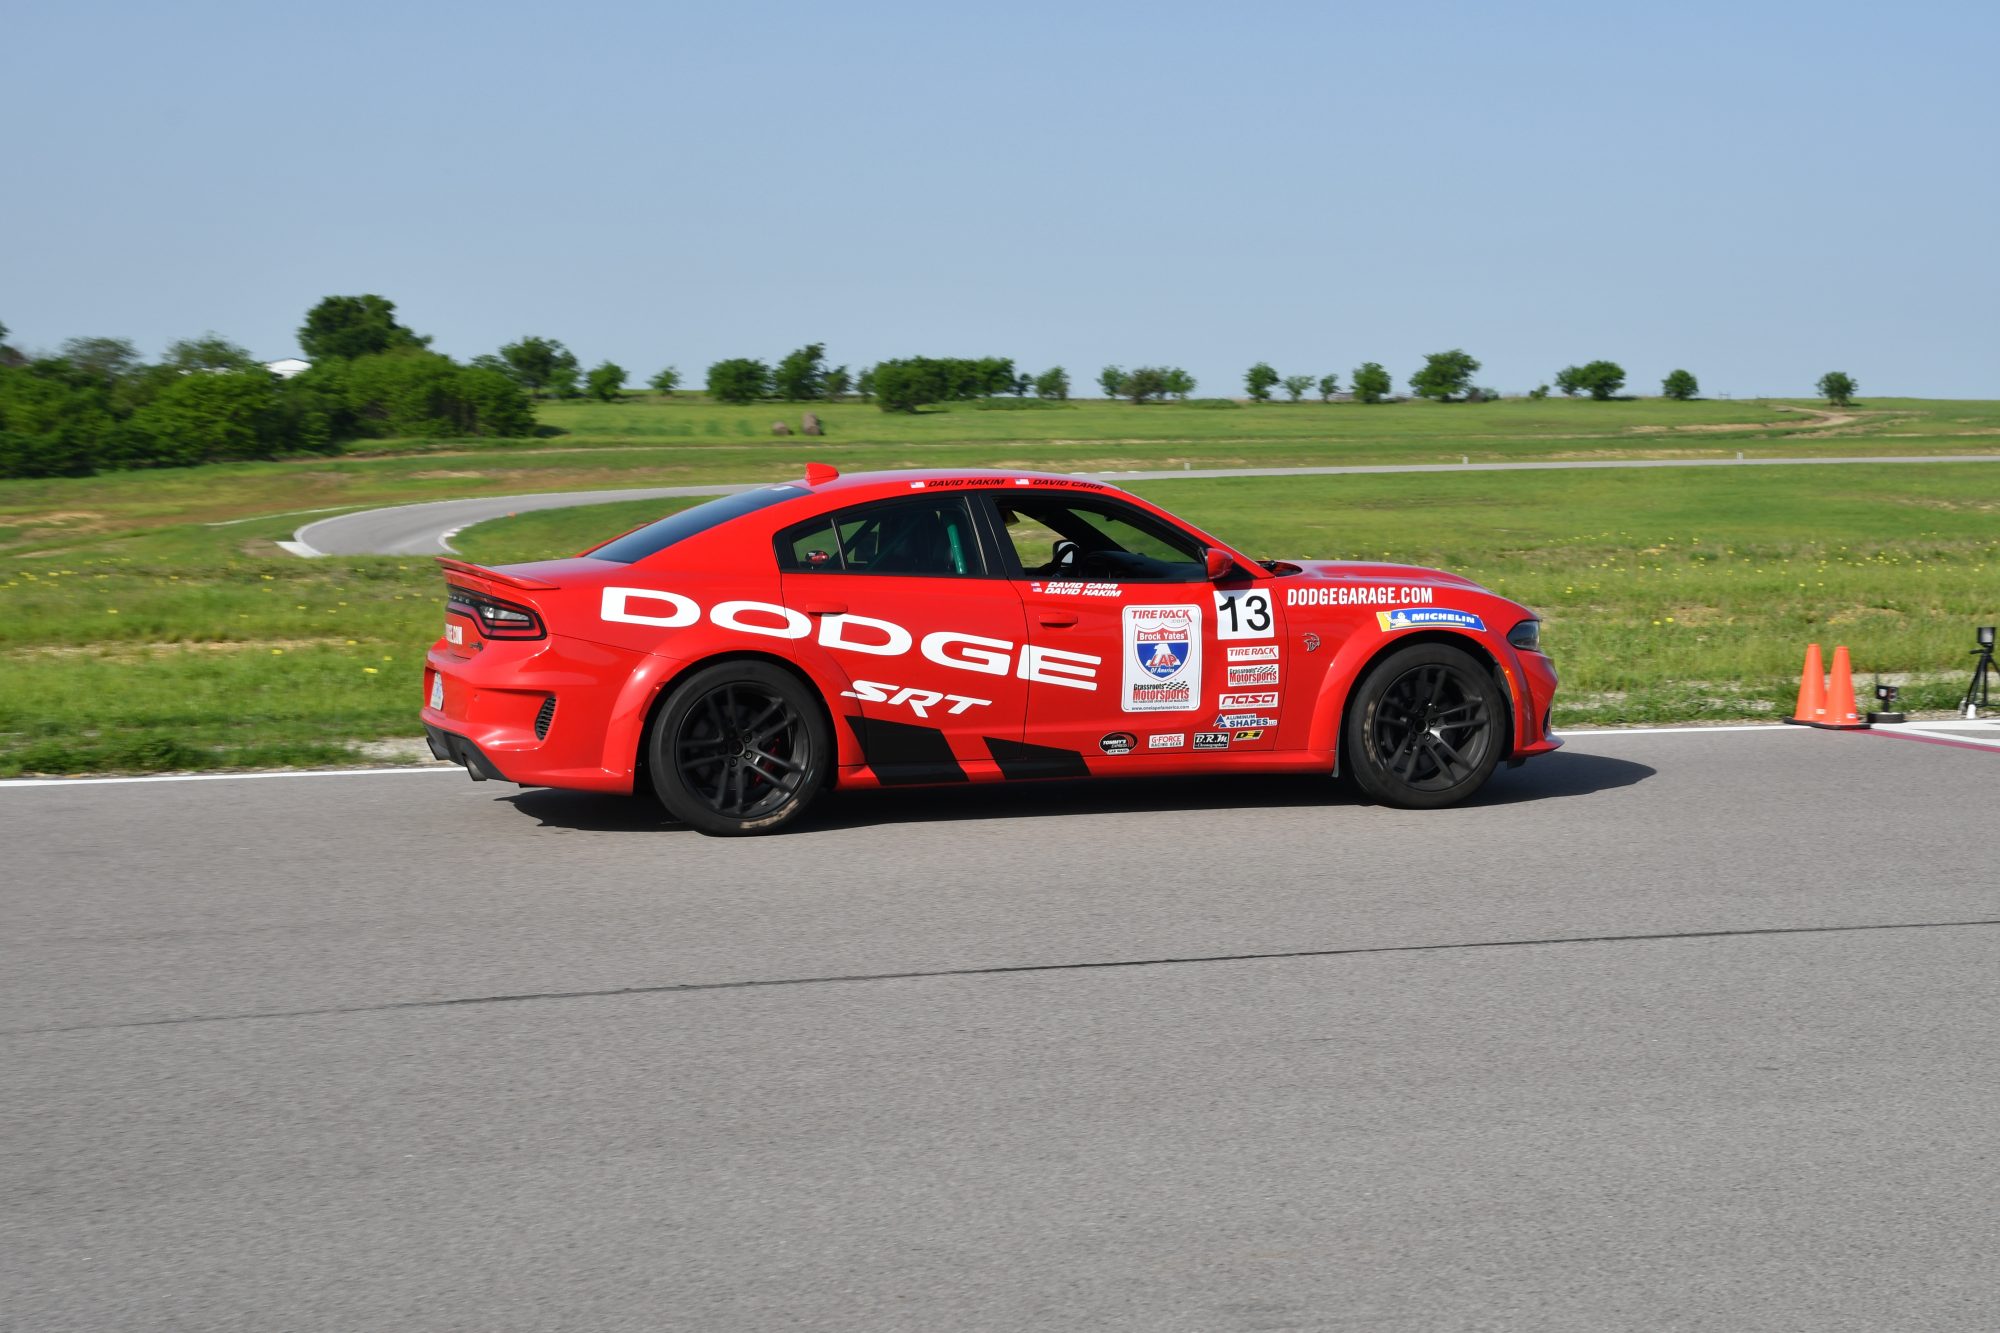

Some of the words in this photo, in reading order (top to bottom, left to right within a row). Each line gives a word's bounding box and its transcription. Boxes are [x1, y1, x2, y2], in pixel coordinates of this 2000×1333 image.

[928, 479, 964, 487] DAVID
[1033, 479, 1068, 487] DAVID
[1072, 480, 1104, 490] CARR
[1047, 581, 1084, 589] DAVID
[1086, 582, 1118, 590] CARR
[1044, 587, 1081, 595] DAVID
[1082, 589, 1122, 597] HAKIM
[1287, 587, 1433, 606] DODGEGARAGE.COM
[1219, 595, 1270, 632] 13
[1411, 612, 1475, 624] MICHELIN
[601, 586, 1101, 690] DODGE
[1139, 632, 1161, 640] Brock
[1149, 654, 1178, 667] LAP
[1229, 671, 1277, 683] Motorsports
[1133, 683, 1165, 691] Grassroots
[840, 680, 992, 718] SRT
[1133, 689, 1189, 702] Motorsports
[1229, 718, 1268, 727] SHAPES
